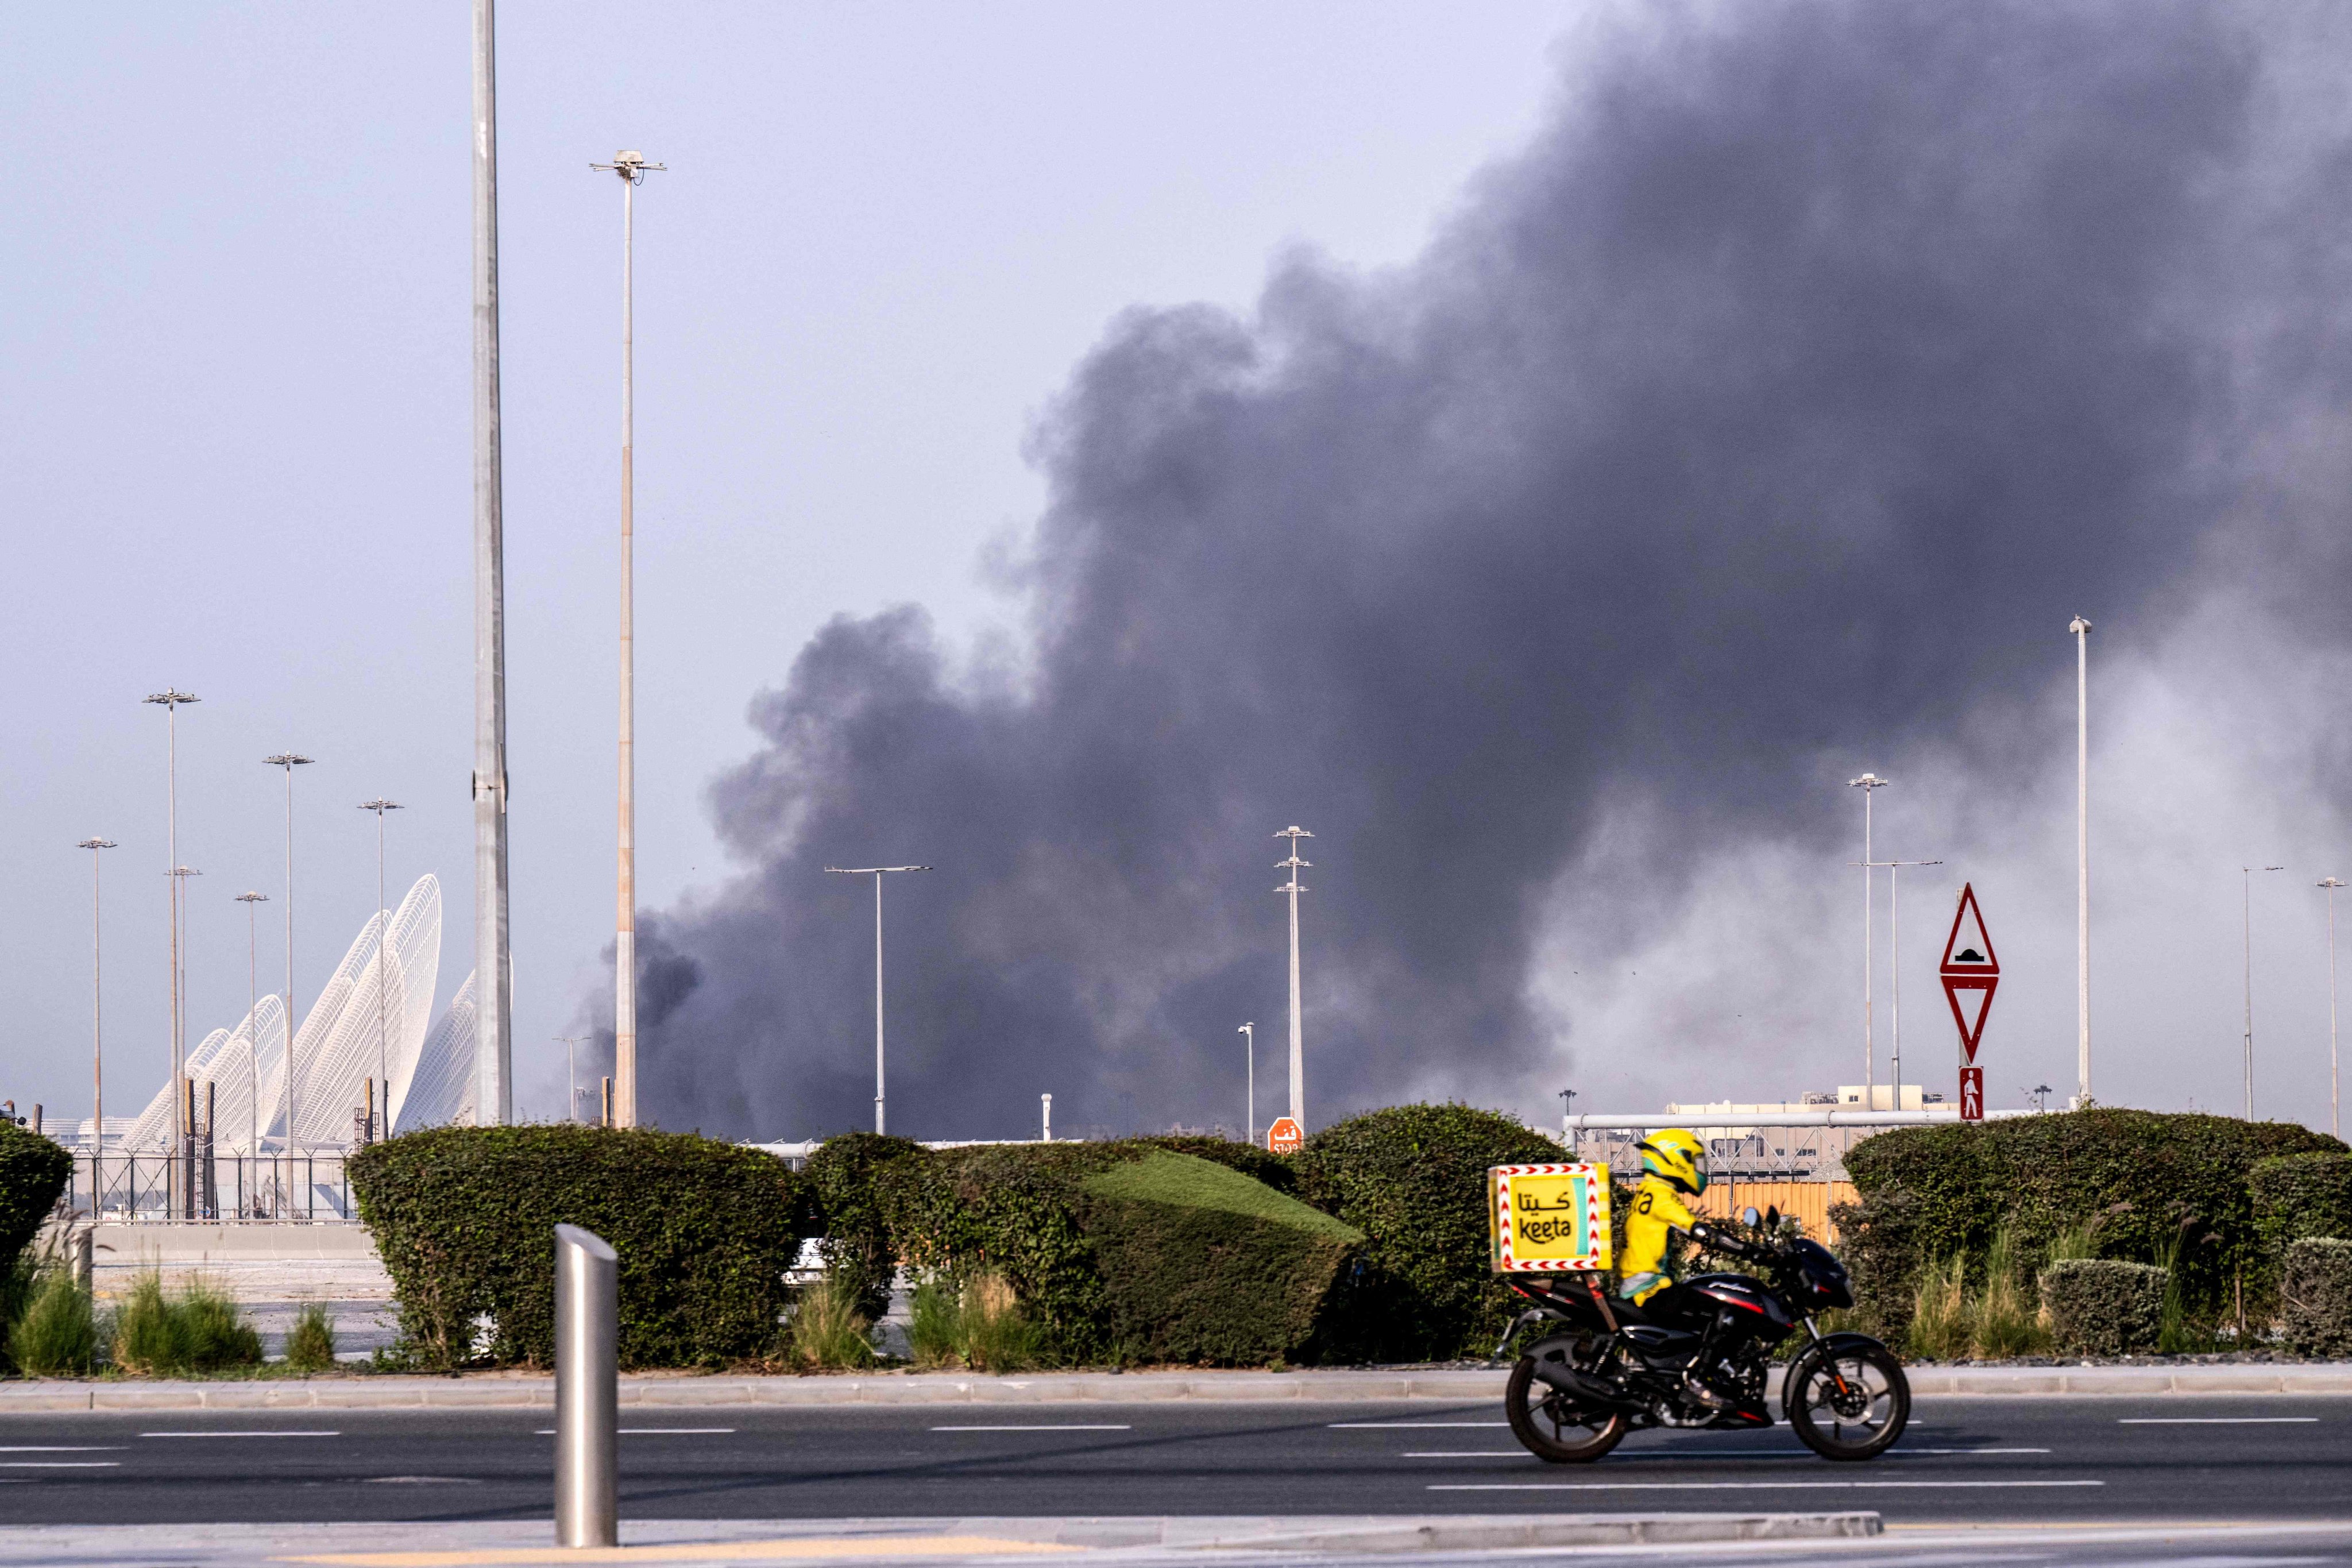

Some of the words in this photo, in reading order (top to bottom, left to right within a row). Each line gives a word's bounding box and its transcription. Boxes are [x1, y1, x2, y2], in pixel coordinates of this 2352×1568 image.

[1275, 1126, 1296, 1140] قف
[1518, 1192, 1570, 1216] كيتا
[1519, 1217, 1571, 1245] keeta
